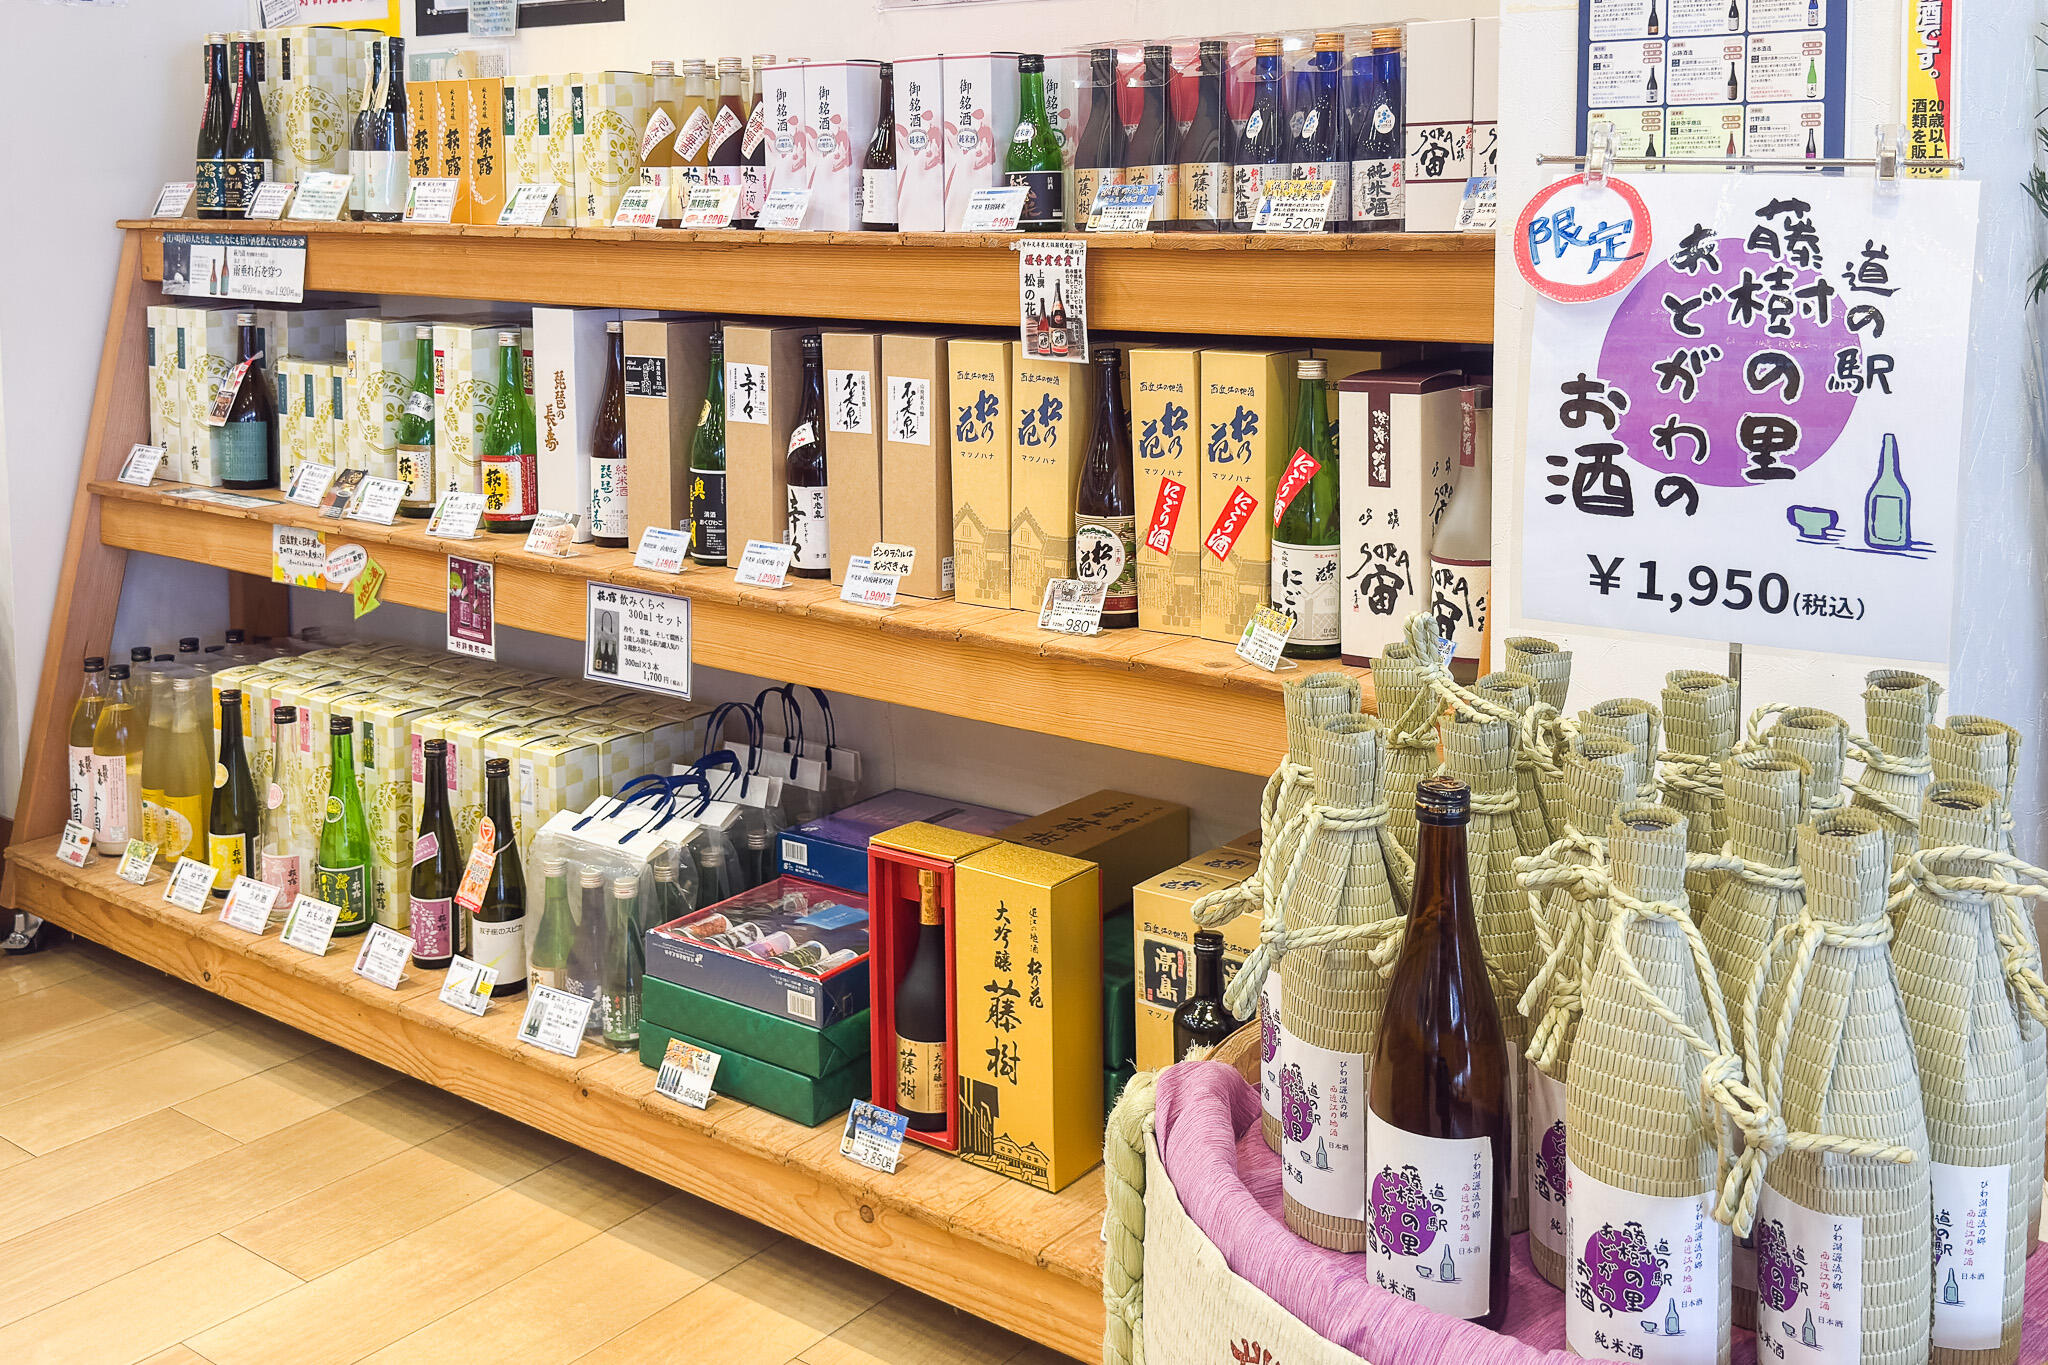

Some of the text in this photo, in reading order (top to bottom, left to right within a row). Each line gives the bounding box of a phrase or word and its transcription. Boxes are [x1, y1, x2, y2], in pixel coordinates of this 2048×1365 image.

[776, 88, 788, 132] 御銘酒
[819, 85, 830, 131] 御銘酒
[909, 82, 921, 128] 御銘酒
[960, 79, 972, 126] 御銘酒
[1411, 127, 1456, 160] SORA
[1192, 169, 1210, 212] 藤樹
[1235, 167, 1250, 220] 純米酒
[1271, 181, 1324, 191] 滋賀の地酒
[1367, 162, 1391, 217] 純米酒
[1528, 206, 1644, 275] 限定
[233, 264, 283, 278] 雨垂れ石を穿つ
[1024, 273, 1036, 316] 松の花
[1727, 198, 1835, 481] 藤樹の里
[1827, 239, 1900, 395] 道の駅
[1653, 223, 1723, 517] あどがわの
[960, 451, 995, 460] マツノハナ
[1021, 454, 1056, 464] マツノハナ
[1545, 373, 1634, 517] お酒
[615, 464, 628, 497] 純米酒
[1144, 468, 1184, 477] マツノハナ
[1211, 472, 1252, 483] マツノハナ
[1274, 453, 1315, 524] にごり酒
[1150, 481, 1181, 552] にごり酒
[1207, 491, 1251, 557] にごり酒
[1346, 542, 1414, 596] SORA
[619, 594, 666, 610] 飲みくらべ
[628, 609, 683, 628] 300ml セット
[1065, 618, 1090, 633] 980
[994, 900, 1012, 972] 大吟醸
[1029, 906, 1039, 954] 近江の地酒
[984, 978, 1023, 1086] 藤樹
[1147, 1009, 1169, 1021] マツノ
[899, 1047, 918, 1101] 藤樹
[933, 1051, 943, 1082] 大吟醸
[1339, 1060, 1349, 1120] びわ湖源流の郷
[1306, 1082, 1322, 1126] 道の駅
[1329, 1085, 1338, 1137] 西近江の地酒
[1328, 1141, 1349, 1151] 日本酒
[1471, 1152, 1482, 1219] びわ湖源流の郷
[1534, 1151, 1550, 1202] お酒
[1379, 1164, 1396, 1260] あどがわの
[1395, 1163, 1428, 1257] 藤樹の里
[1425, 1182, 1448, 1233] 道の駅
[1460, 1183, 1471, 1243] 西近江の地酒
[1935, 1209, 1954, 1257] 道の駅
[1976, 1180, 1988, 1245] びわ湖源流の郷
[1458, 1246, 1481, 1256] 日本酒
[1651, 1238, 1673, 1287] 道の駅
[1832, 1223, 1844, 1292] びわ湖源流の郷
[1963, 1209, 1975, 1267] 西近江の地酒
[1376, 1269, 1416, 1301] 純米酒
[1574, 1256, 1595, 1313] お酒
[1597, 1222, 1619, 1319] あどがわの
[1618, 1220, 1653, 1313] 藤樹の里
[1682, 1234, 1693, 1295] 西近江の地酒
[1770, 1218, 1791, 1314] 藤樹の里
[1791, 1244, 1809, 1297] 道の駅
[1819, 1251, 1831, 1311] 西近江の地酒
[1961, 1271, 1985, 1281] 日本酒
[1681, 1297, 1703, 1309] 日本酒
[1818, 1315, 1844, 1329] 日本酒
[1594, 1330, 1644, 1360] 純米酒
